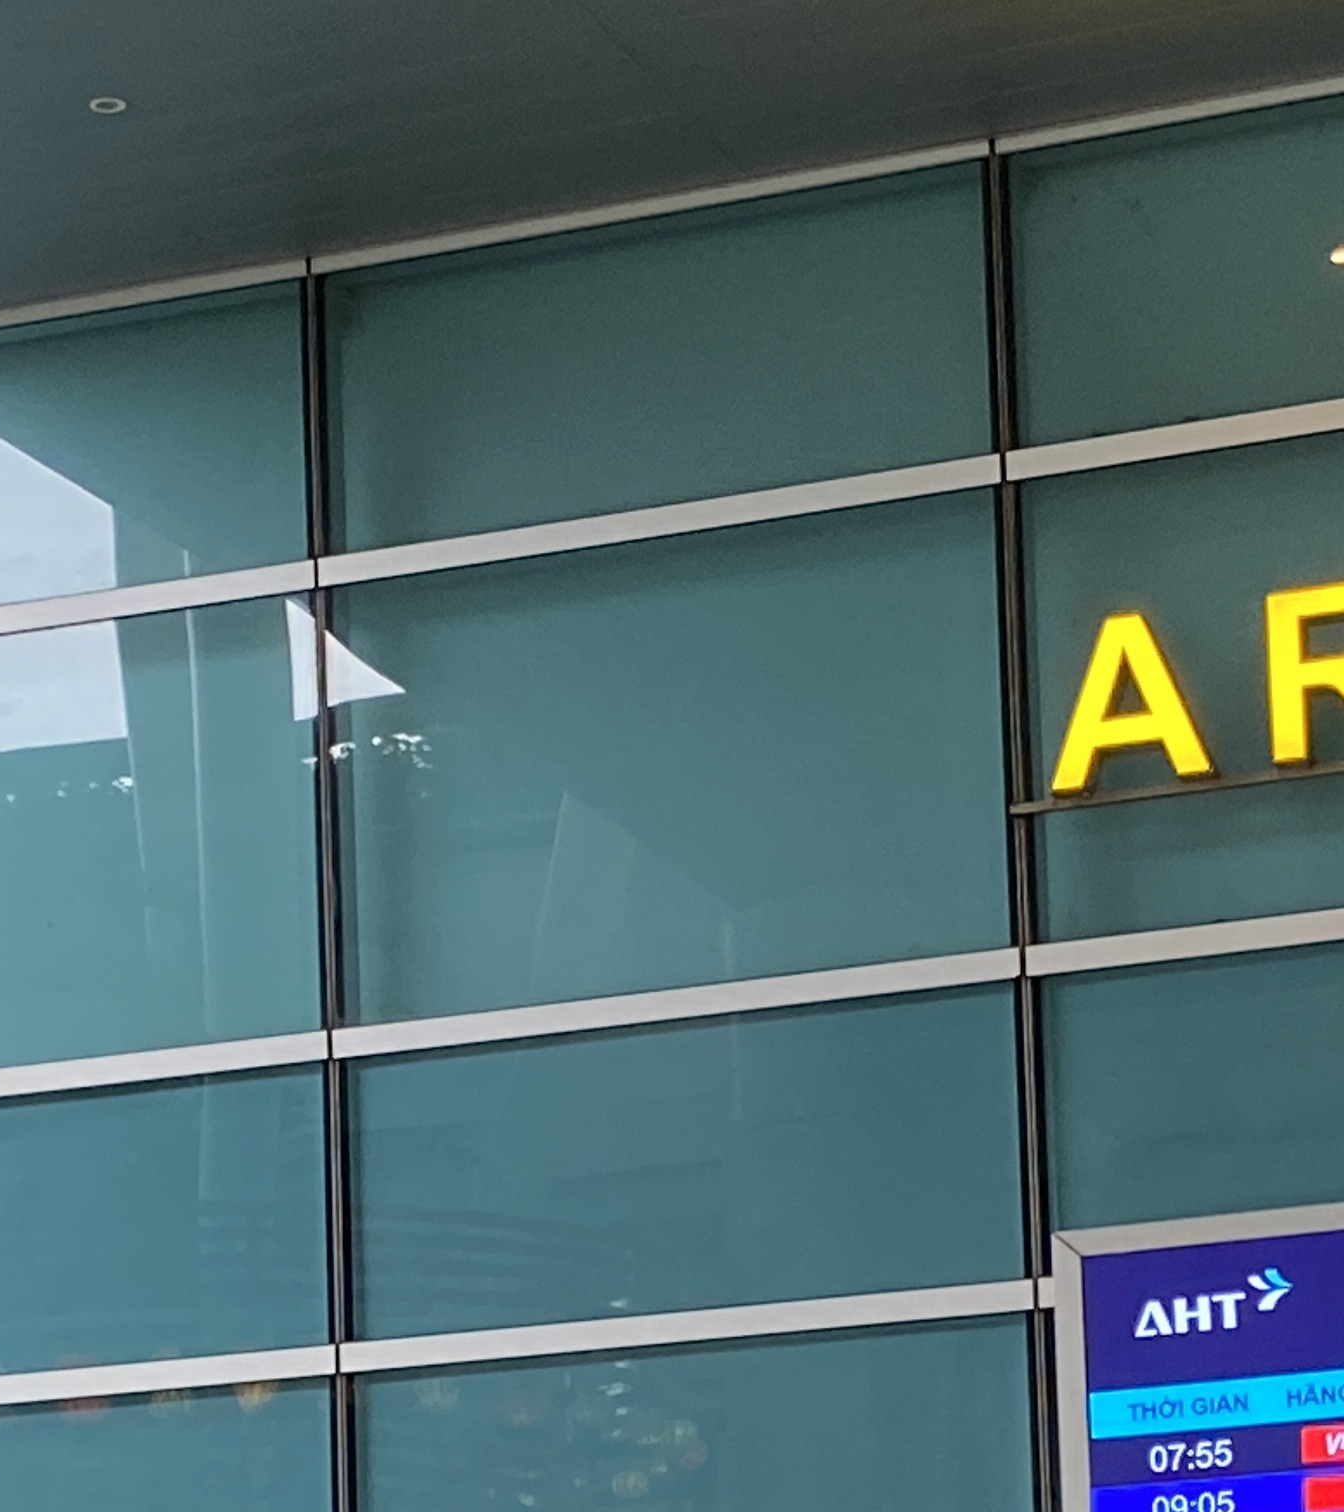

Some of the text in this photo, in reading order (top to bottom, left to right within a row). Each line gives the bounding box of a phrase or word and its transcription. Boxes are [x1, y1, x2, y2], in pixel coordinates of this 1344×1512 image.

[1134, 1291, 1247, 1338] AHT
[1191, 1393, 1249, 1416] GIAN
[1149, 1438, 1233, 1473] 07:55
